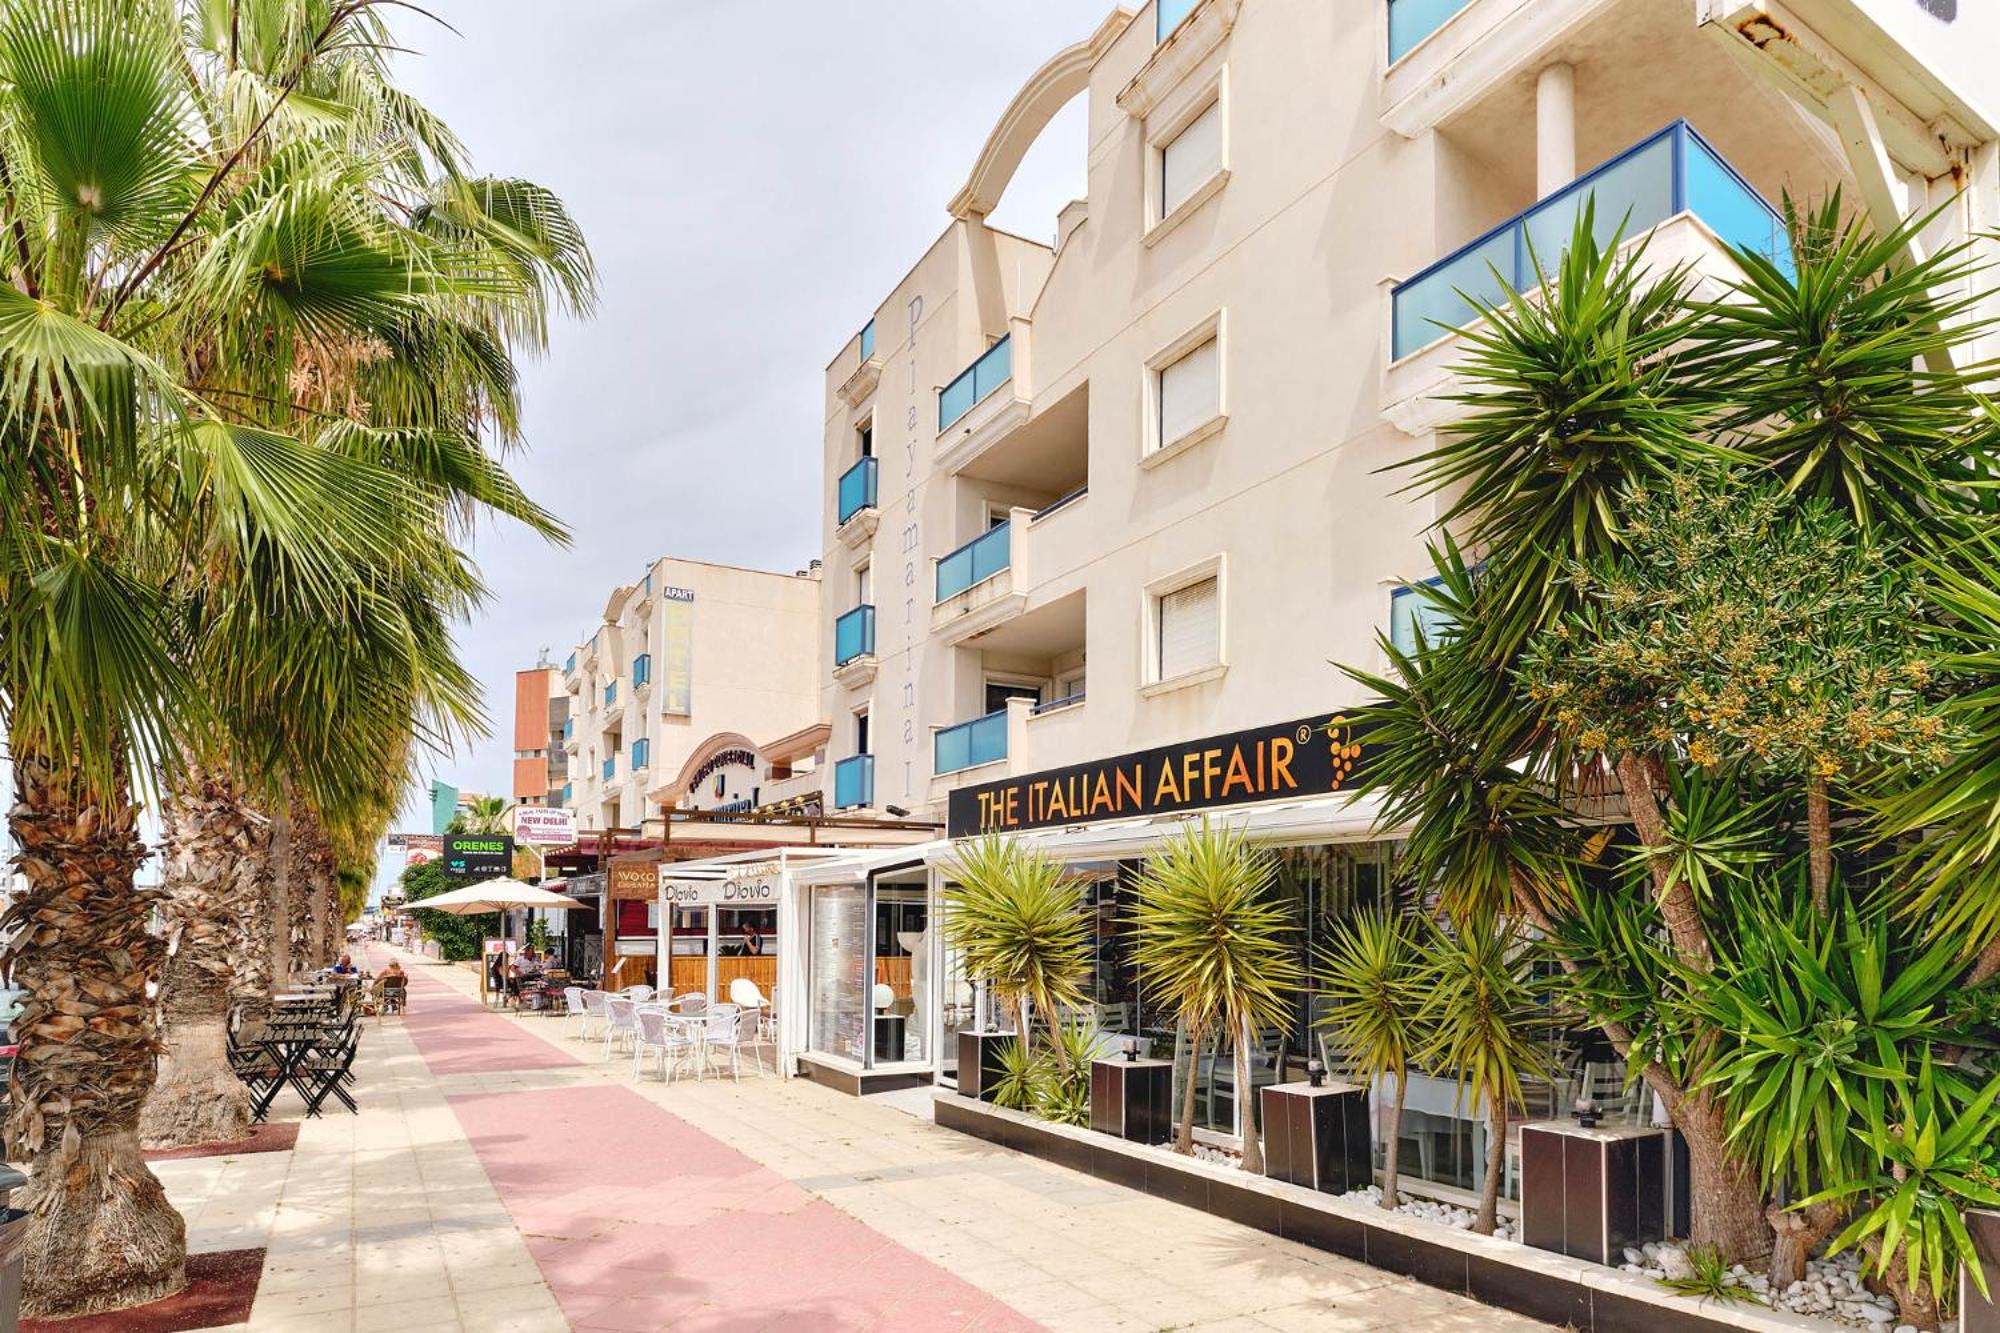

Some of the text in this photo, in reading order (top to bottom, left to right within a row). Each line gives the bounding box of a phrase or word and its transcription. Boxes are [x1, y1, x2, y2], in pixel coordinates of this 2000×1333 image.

[664, 587, 693, 600] APART
[977, 786, 1019, 828] THE
[1027, 763, 1142, 822] ITALIAN
[1153, 737, 1298, 806] AFFAIR
[520, 816, 568, 826] NEW DELHI
[452, 840, 505, 851] ORENES
